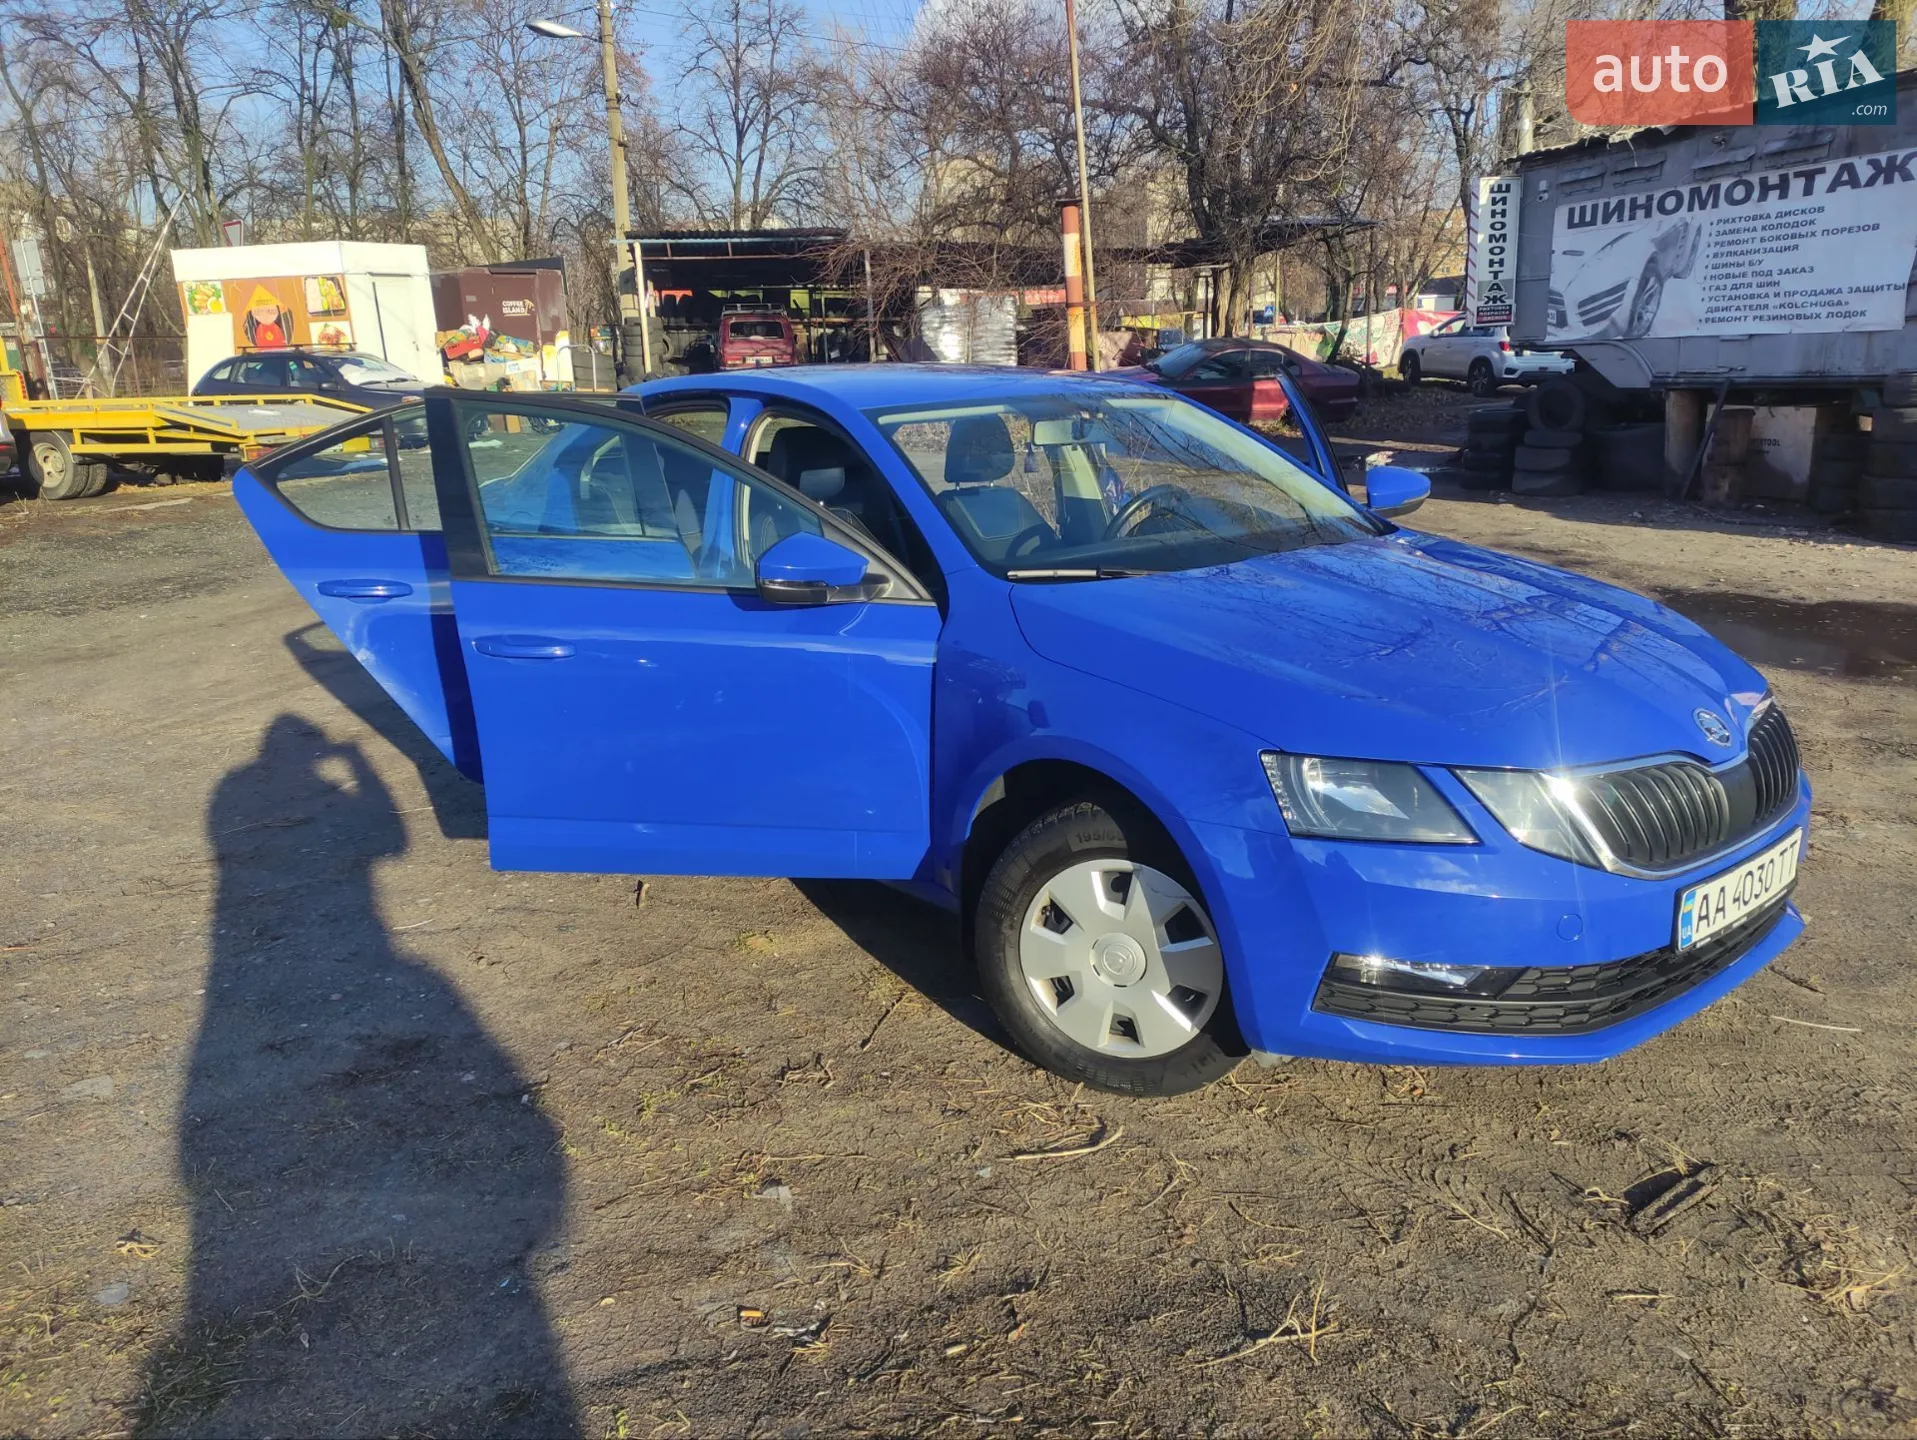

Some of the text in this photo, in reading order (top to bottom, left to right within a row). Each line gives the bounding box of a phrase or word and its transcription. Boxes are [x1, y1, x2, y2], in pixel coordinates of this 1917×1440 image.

[1566, 153, 1917, 230] ШИНОМОНТАЖ
[1716, 206, 1825, 226] РИХТОВКА ДИСКОВ
[1713, 223, 1880, 248] РЕМОНТ БОКОВЫХ ПОРЕЗОВ
[1715, 218, 1817, 238] ЗАМЕНА КОЛОДОК
[1484, 183, 1511, 305] ШИНОМОНТАЖ
[1712, 244, 1799, 259] ВУЛКАНИЗАЦИЯ
[1709, 266, 1814, 280] НОВЫЕ ПОД ЗАКАЗ
[1711, 259, 1764, 270] ШИНЫ Б/У
[1708, 283, 1906, 303] УСТАНОВКА И ПРОДАЖА ЗАЩИТЫ
[1709, 280, 1780, 292] ГАЗ ДЛЯ ШИН
[1704, 309, 1868, 324] РЕМОНТ РЕЗИНОВЫХ ЛОДОК
[1705, 304, 1769, 315] ДВИГАТЕЛЯ
[1696, 839, 1798, 933] AA 4030 TT
[1681, 925, 1691, 940] UA
